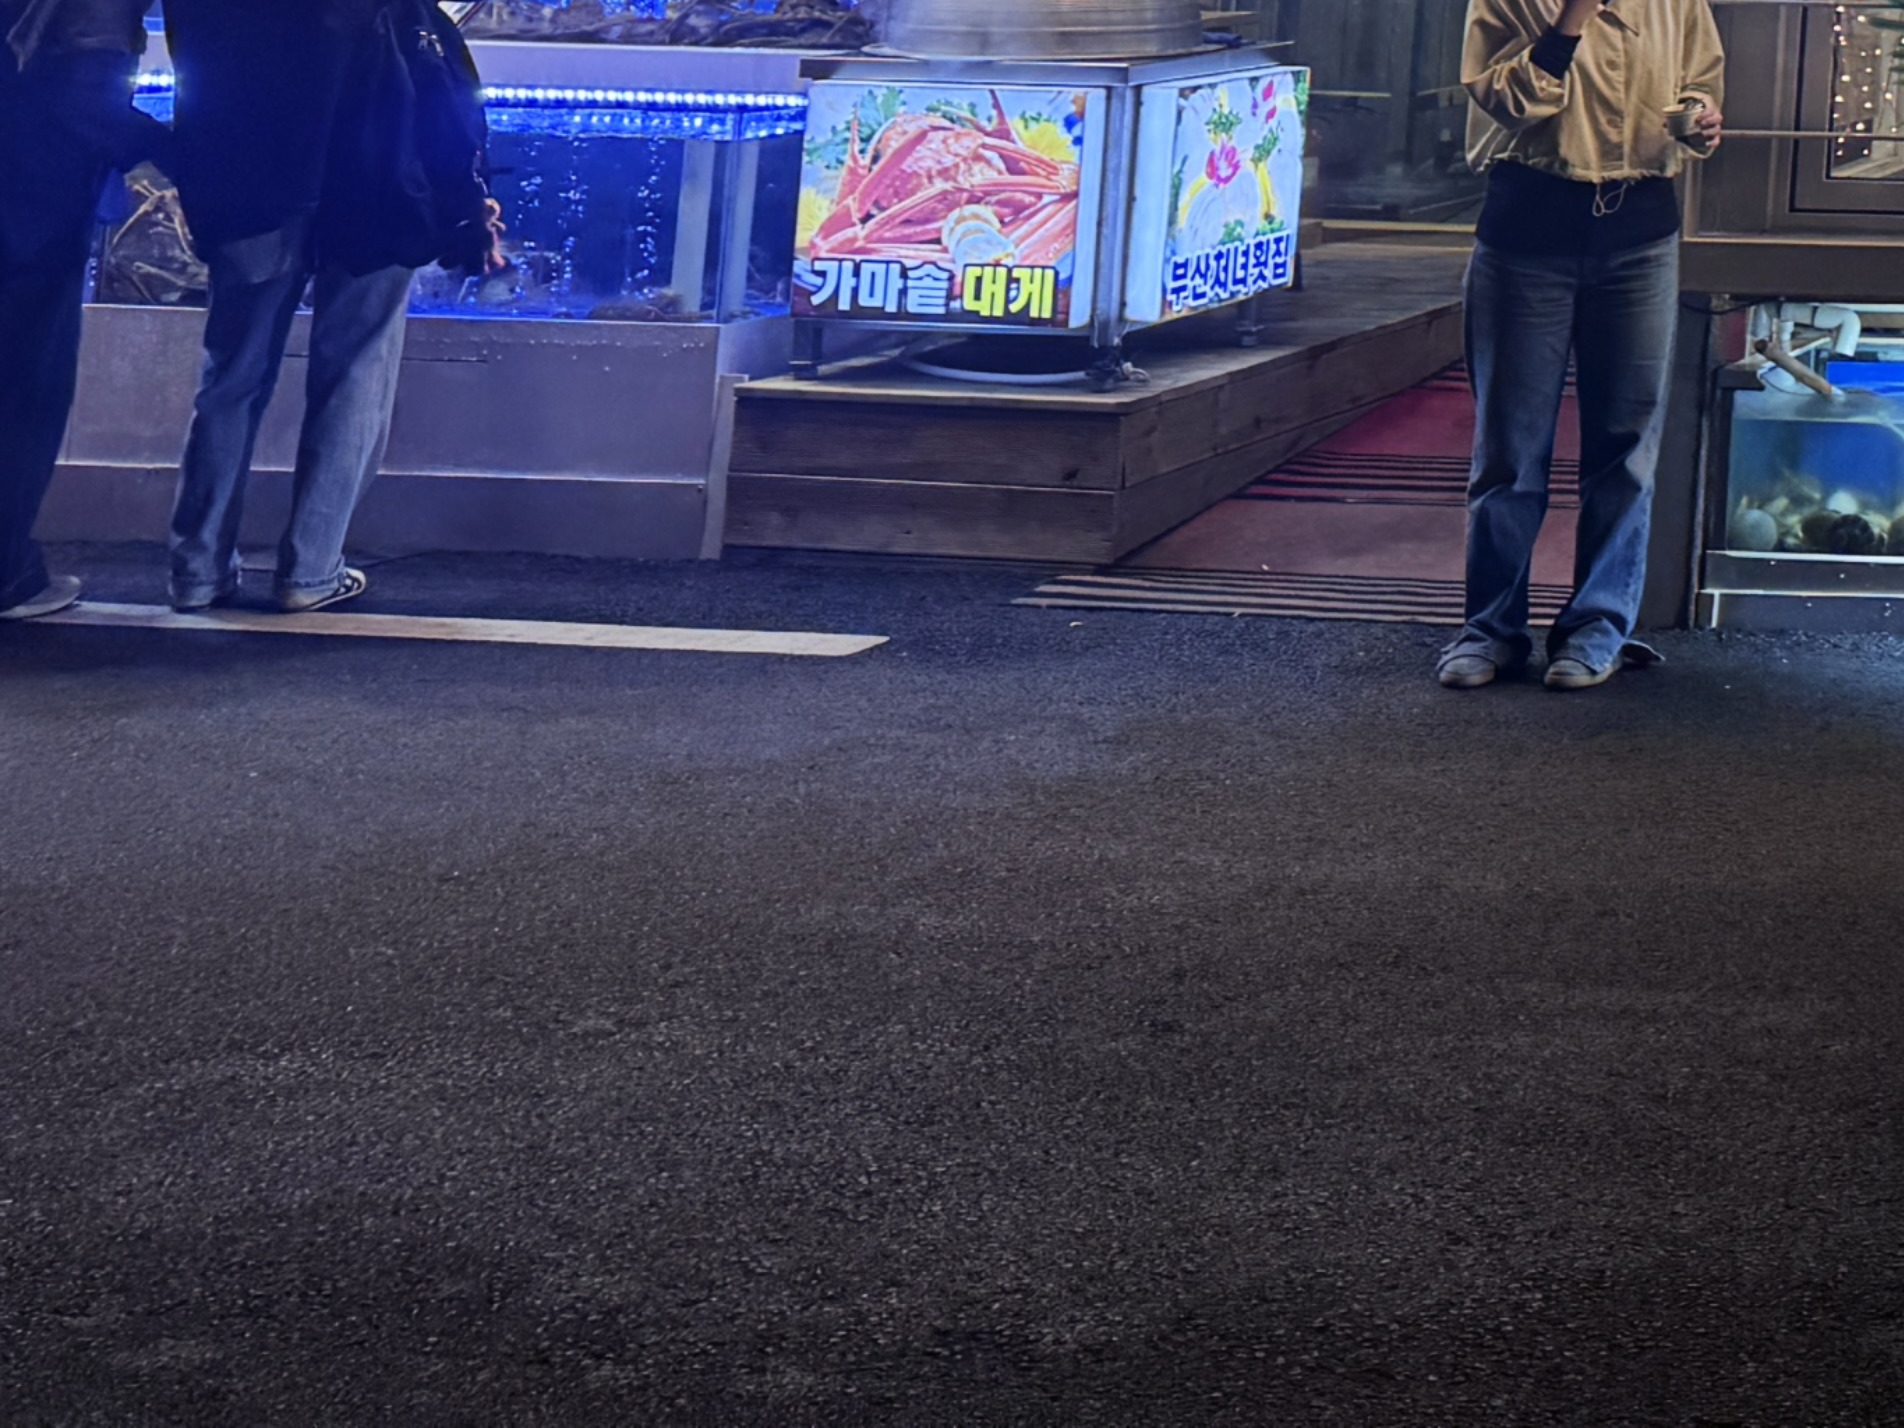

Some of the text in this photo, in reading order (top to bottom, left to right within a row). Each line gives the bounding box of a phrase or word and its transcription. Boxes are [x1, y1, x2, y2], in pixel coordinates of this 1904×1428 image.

[810, 259, 1056, 319] 가마솥 대게
[1168, 231, 1291, 312] 부산처녀횟집
